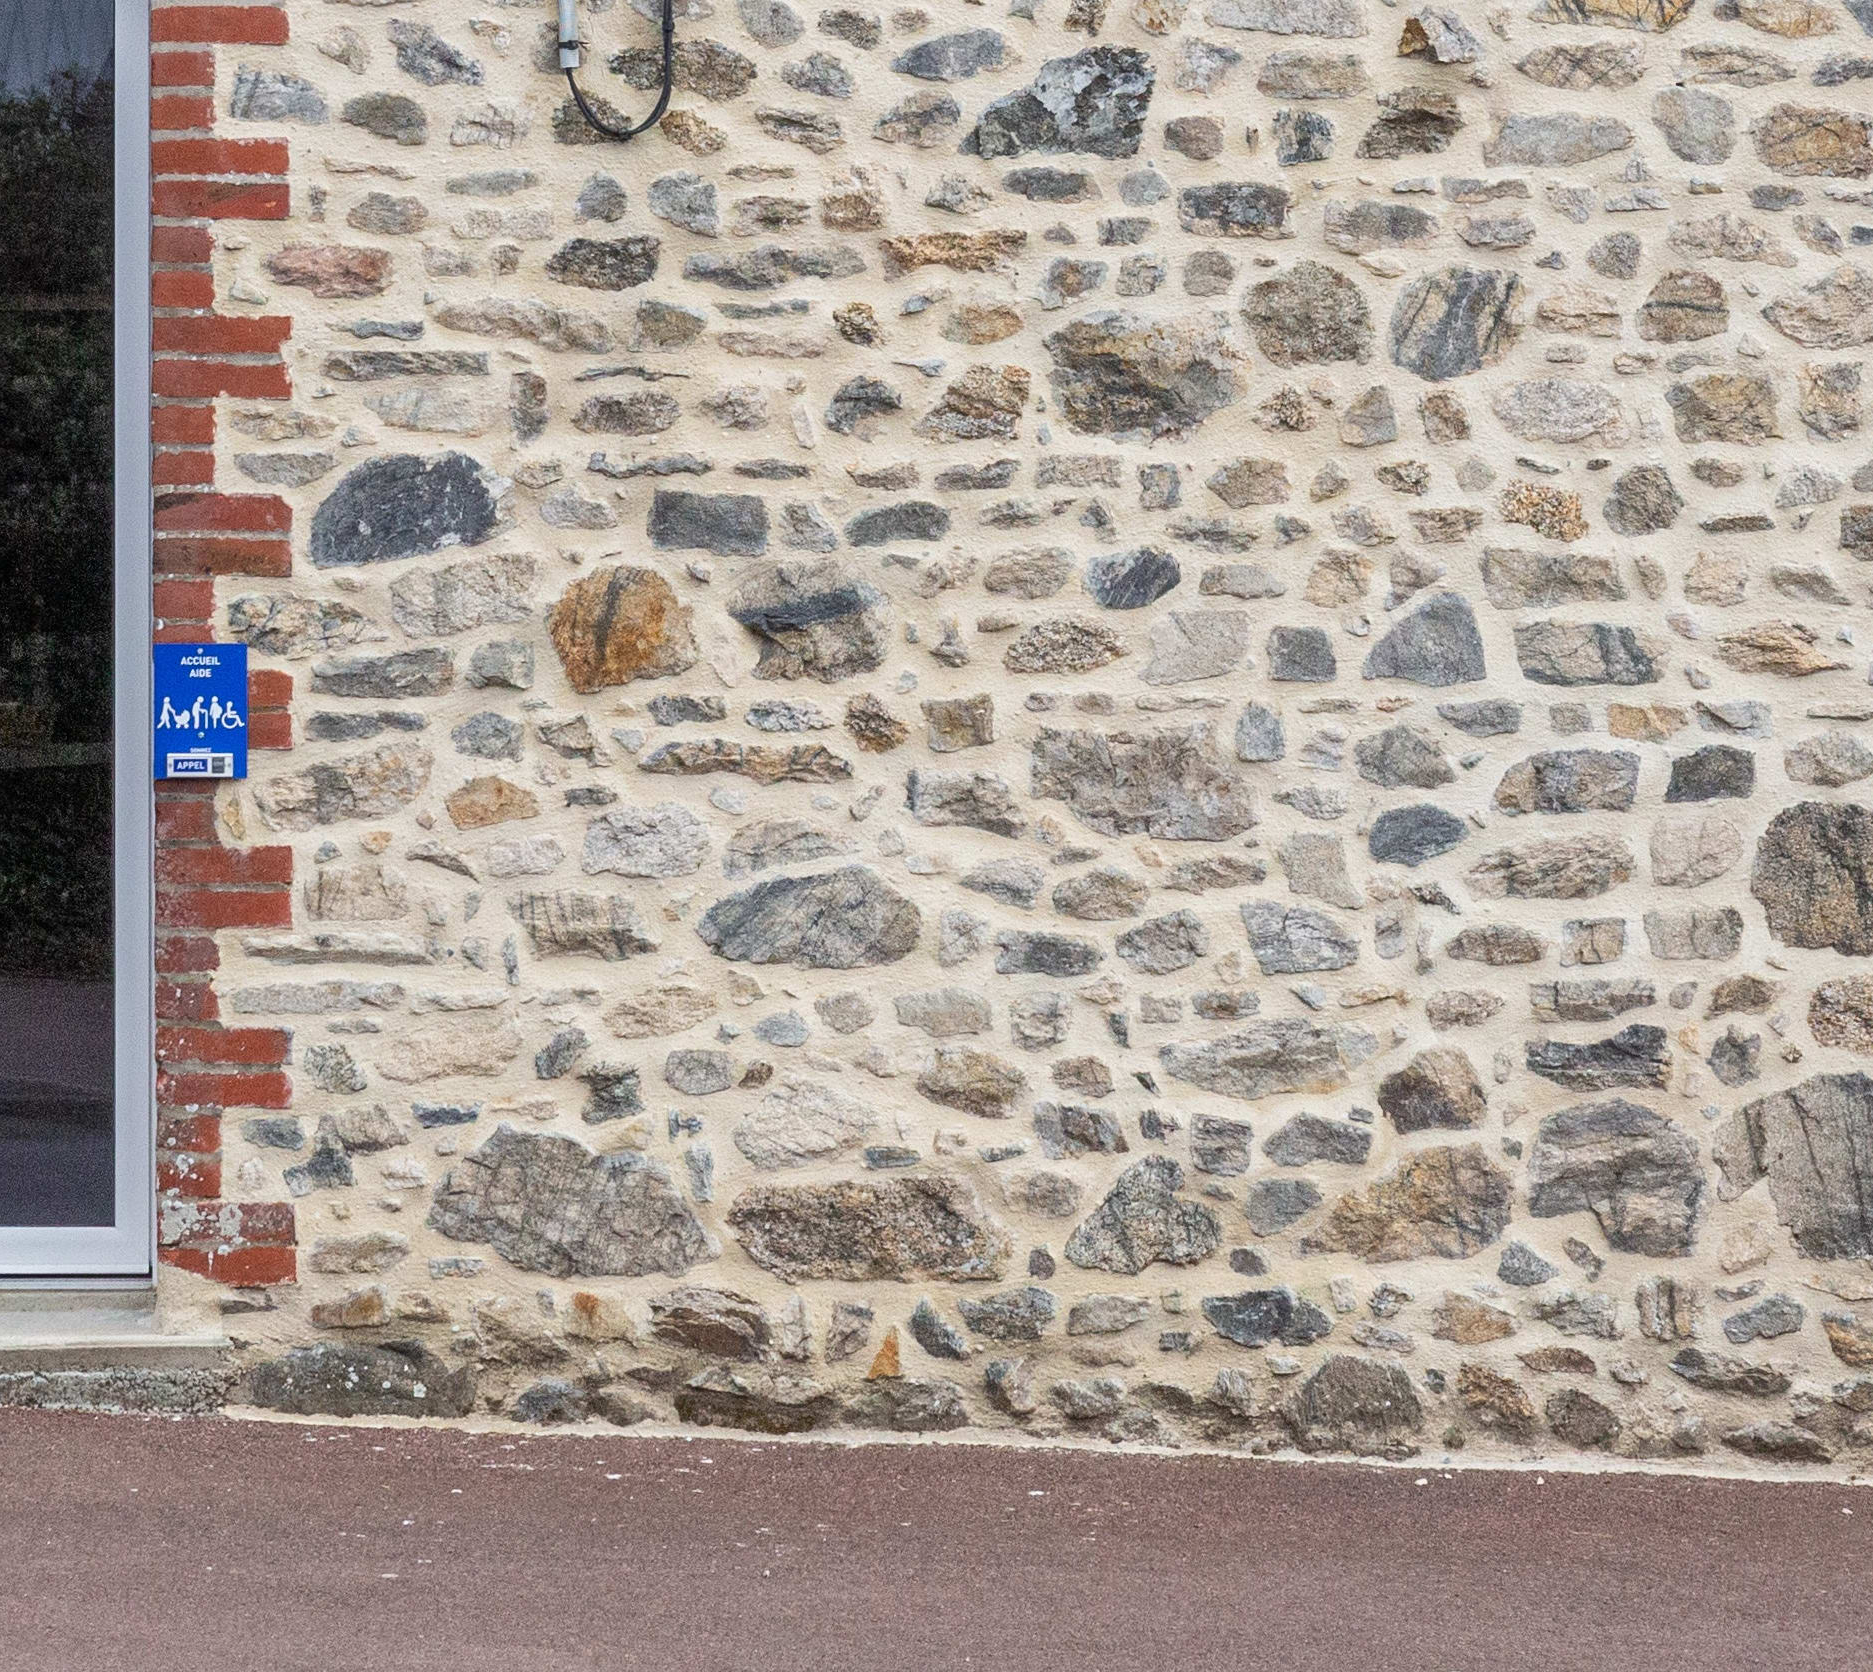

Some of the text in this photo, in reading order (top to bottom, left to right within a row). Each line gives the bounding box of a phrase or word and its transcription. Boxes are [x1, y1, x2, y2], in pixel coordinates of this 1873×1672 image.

[181, 657, 220, 665] ACCUEIL
[190, 669, 211, 677] AIDE
[177, 761, 205, 770] APPEL
